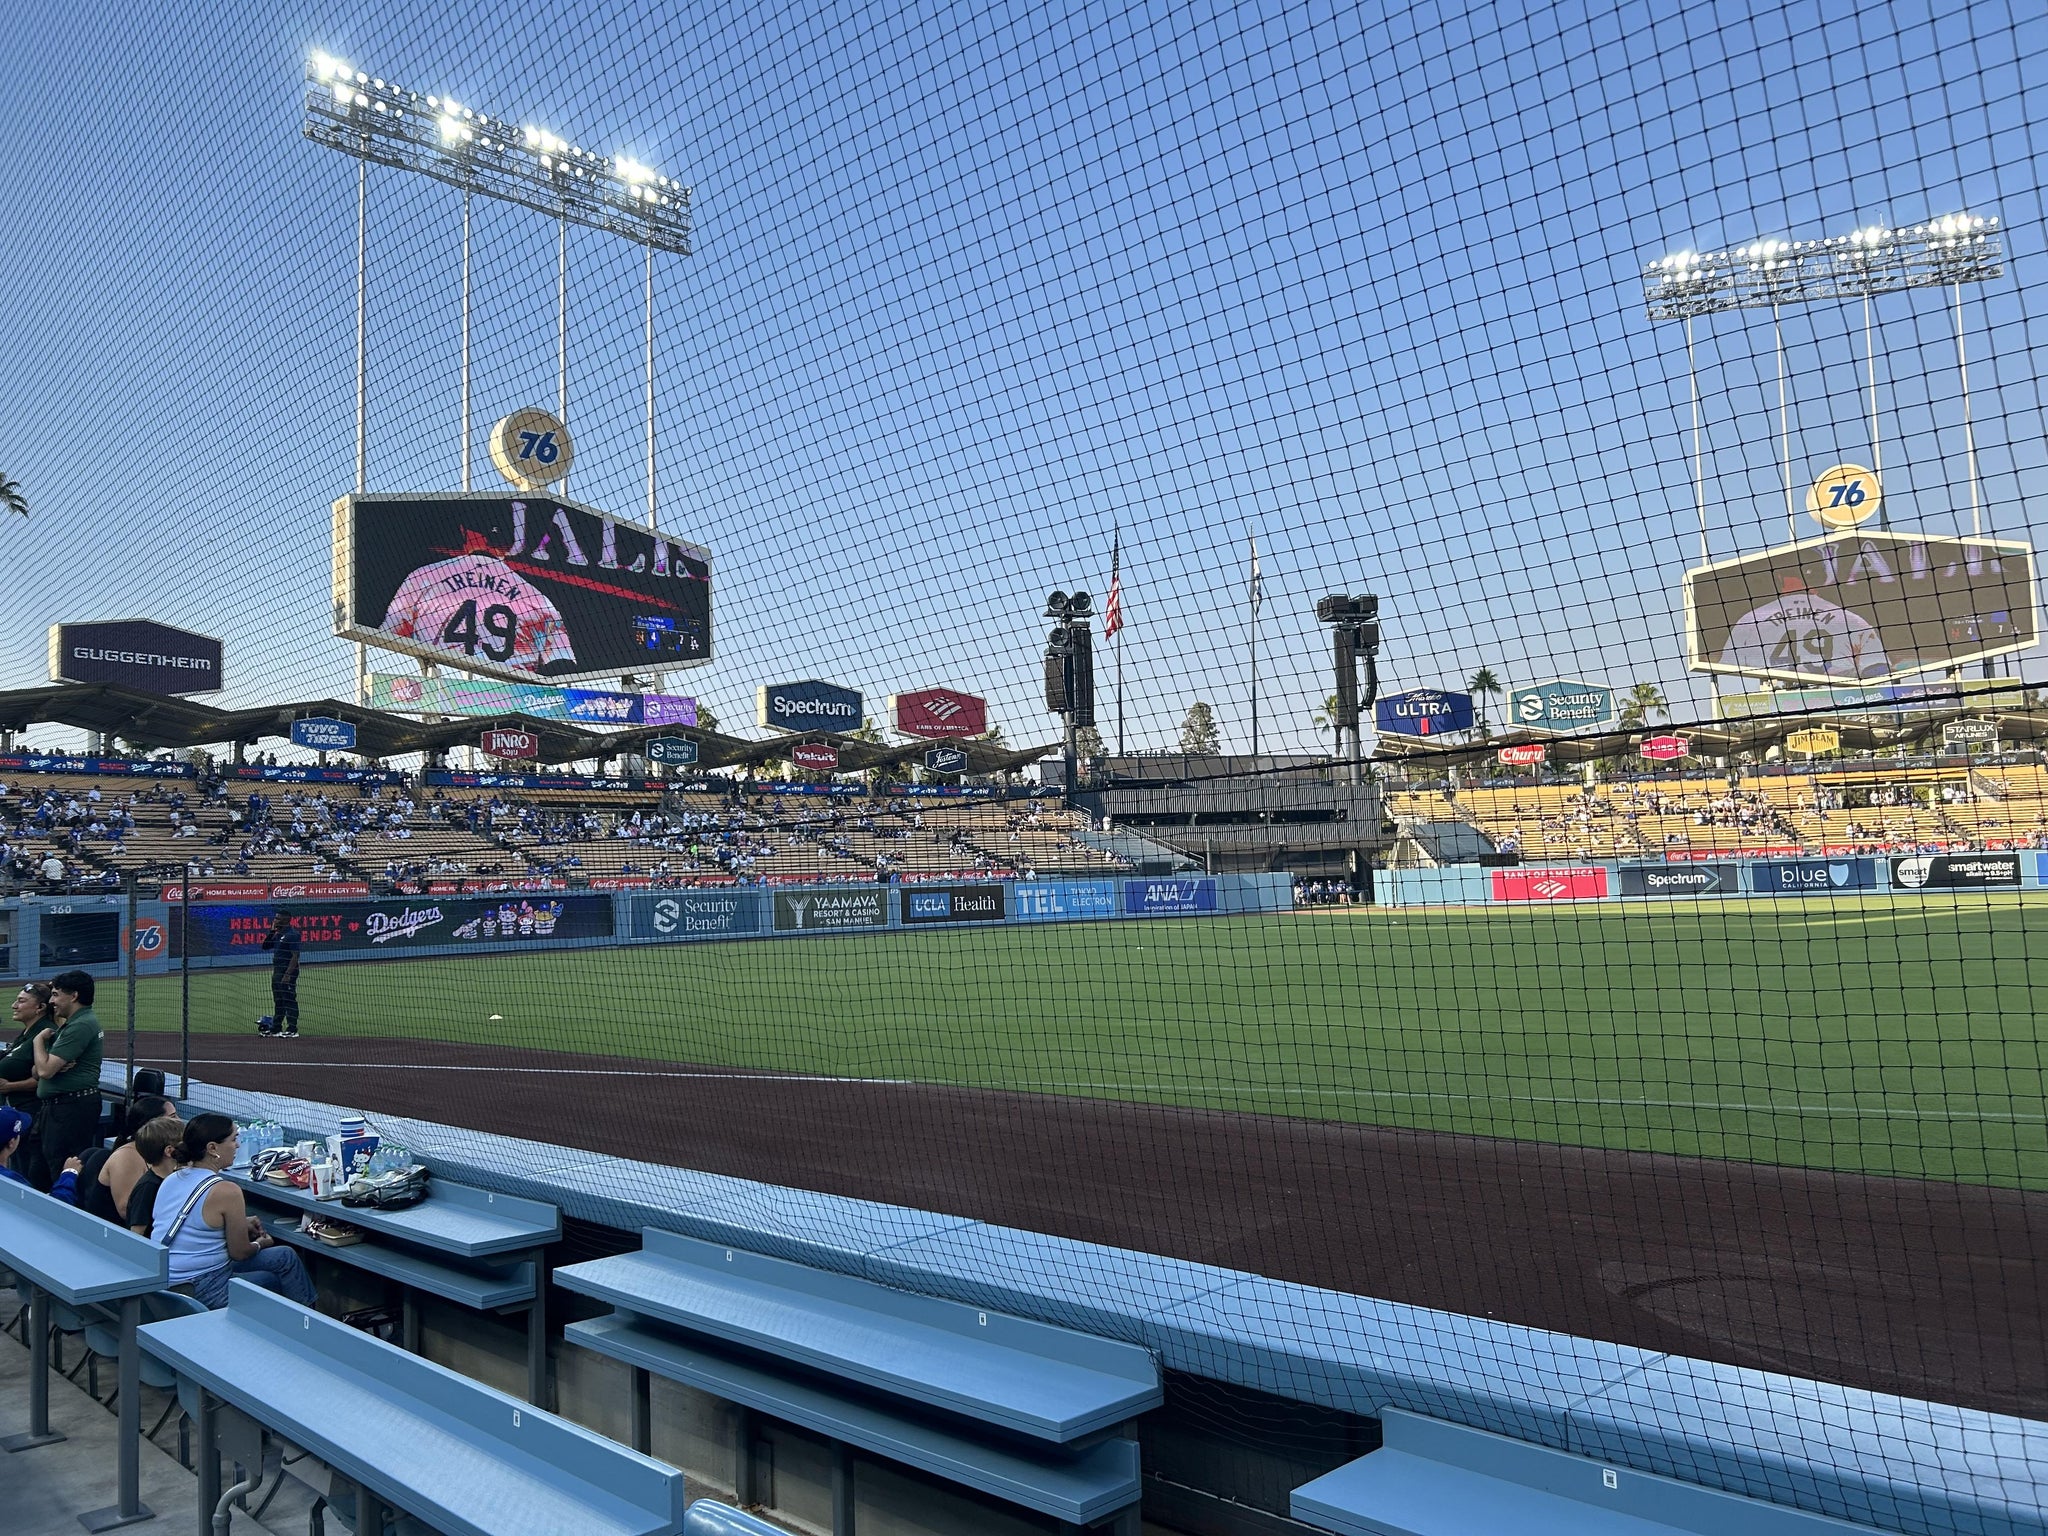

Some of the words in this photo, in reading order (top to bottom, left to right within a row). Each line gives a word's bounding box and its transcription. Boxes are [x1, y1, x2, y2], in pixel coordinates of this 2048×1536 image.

[518, 431, 558, 463] 76
[1828, 481, 1866, 508] 76
[440, 572, 521, 600] TREINEN
[1767, 608, 1836, 627] TREINEN
[444, 600, 517, 662] 49
[74, 647, 211, 670] GUGGENHEIM
[1770, 629, 1833, 673] 49
[774, 696, 851, 717] Spectrum
[1549, 693, 1603, 706] Security
[1396, 702, 1452, 716] ULTRA
[1550, 706, 1598, 719] Benefit
[1947, 724, 1994, 733] STARLUX
[306, 734, 348, 745] TIRES
[1792, 735, 1808, 748] JIM
[667, 744, 693, 752] Security
[667, 751, 690, 759] Benefit
[1501, 748, 1541, 760] Churu
[1781, 866, 1827, 882] blue
[1948, 861, 2014, 872] smartwater
[1648, 874, 1706, 887] Spectrum
[1144, 885, 1178, 902] ANA
[685, 899, 738, 916] Security
[915, 898, 946, 911] UCLA
[953, 896, 996, 911] Health
[1018, 889, 1063, 914] TEL
[1072, 897, 1112, 907] ELECTRON
[51, 906, 72, 914] 360
[814, 910, 842, 918] RESORT
[851, 908, 880, 916] CASINO
[230, 917, 273, 930] HELL
[290, 915, 343, 928] KITTY
[366, 906, 443, 944] Dodgers
[686, 914, 730, 931] Benefit
[843, 917, 873, 925] MANUEL
[230, 932, 268, 945] AND
[301, 930, 342, 942] ENDS
